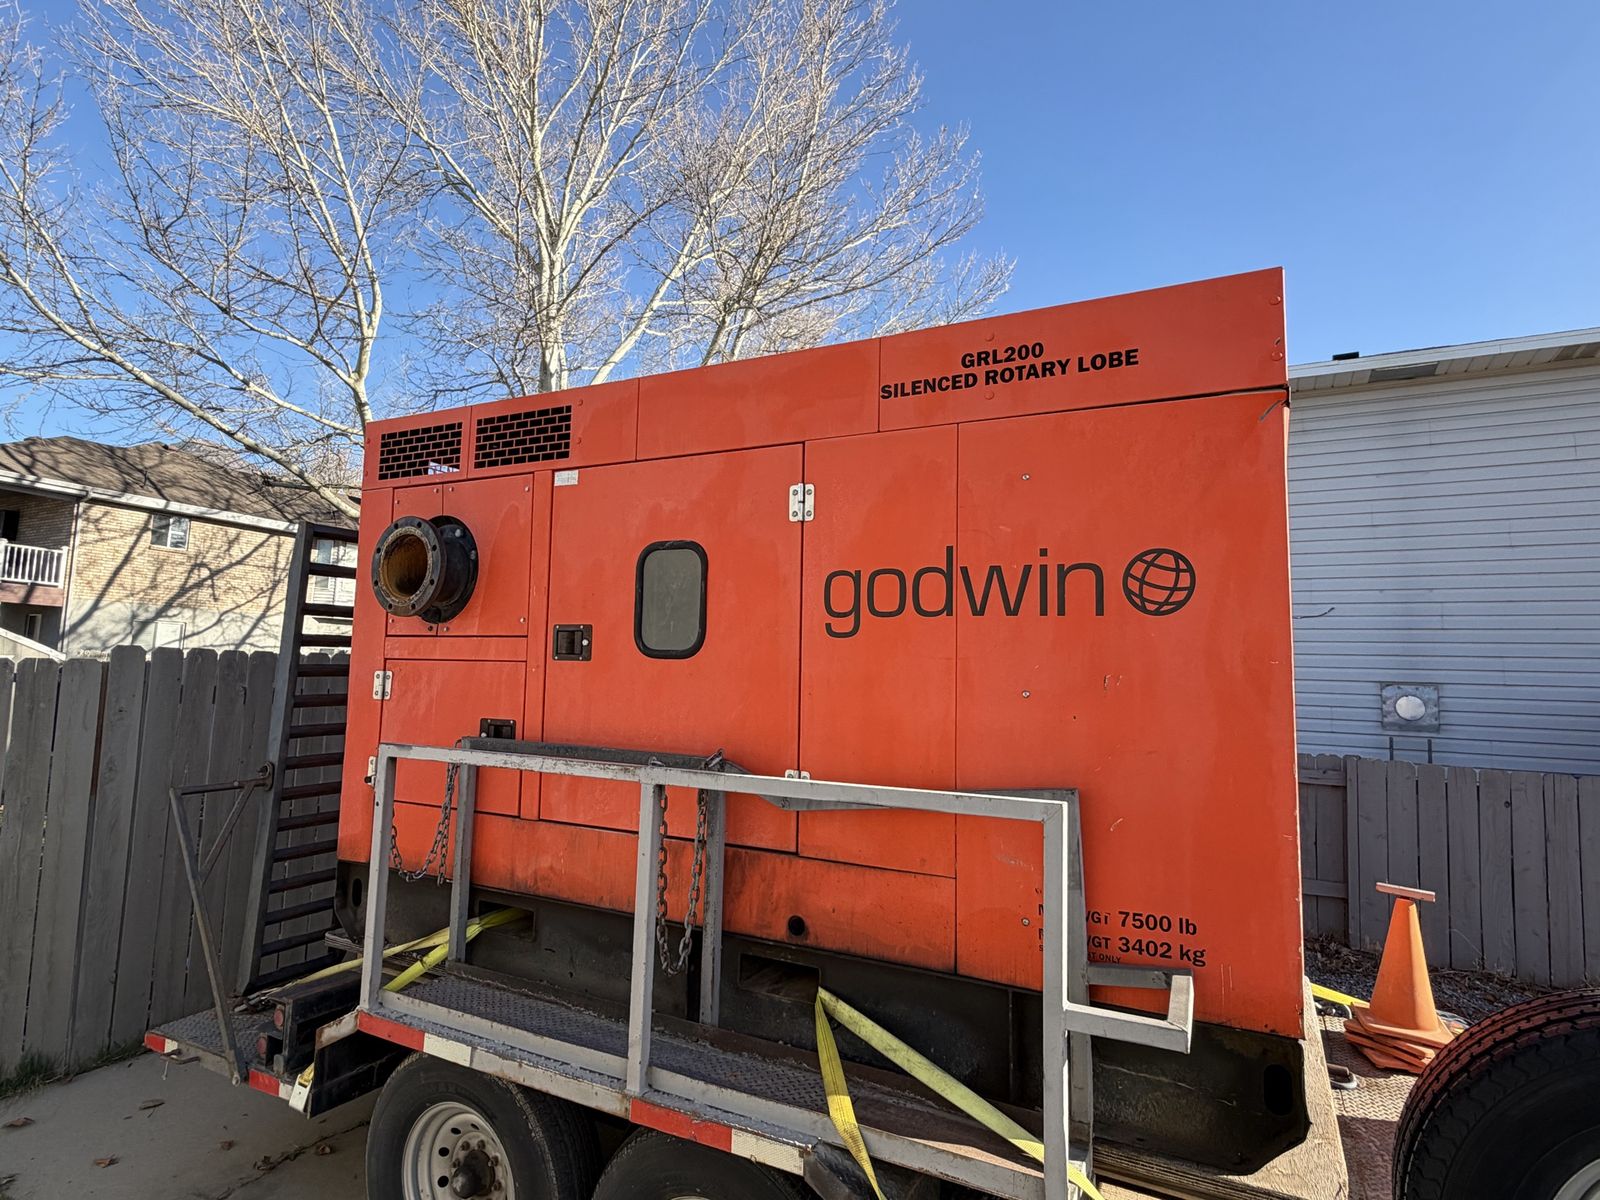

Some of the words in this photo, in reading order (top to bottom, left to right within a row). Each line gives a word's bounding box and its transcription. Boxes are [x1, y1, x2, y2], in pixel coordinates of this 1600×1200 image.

[961, 342, 1044, 369] GRL200
[880, 372, 978, 399] SILENCED
[985, 358, 1071, 386] ROTARY
[1077, 348, 1139, 373] LOBE
[823, 545, 1105, 639] godwin
[1118, 910, 1172, 933] 7500
[1178, 917, 1198, 936] lb
[1098, 952, 1122, 965] ONLY
[1118, 936, 1173, 960] 3402
[1179, 944, 1207, 968] kg
